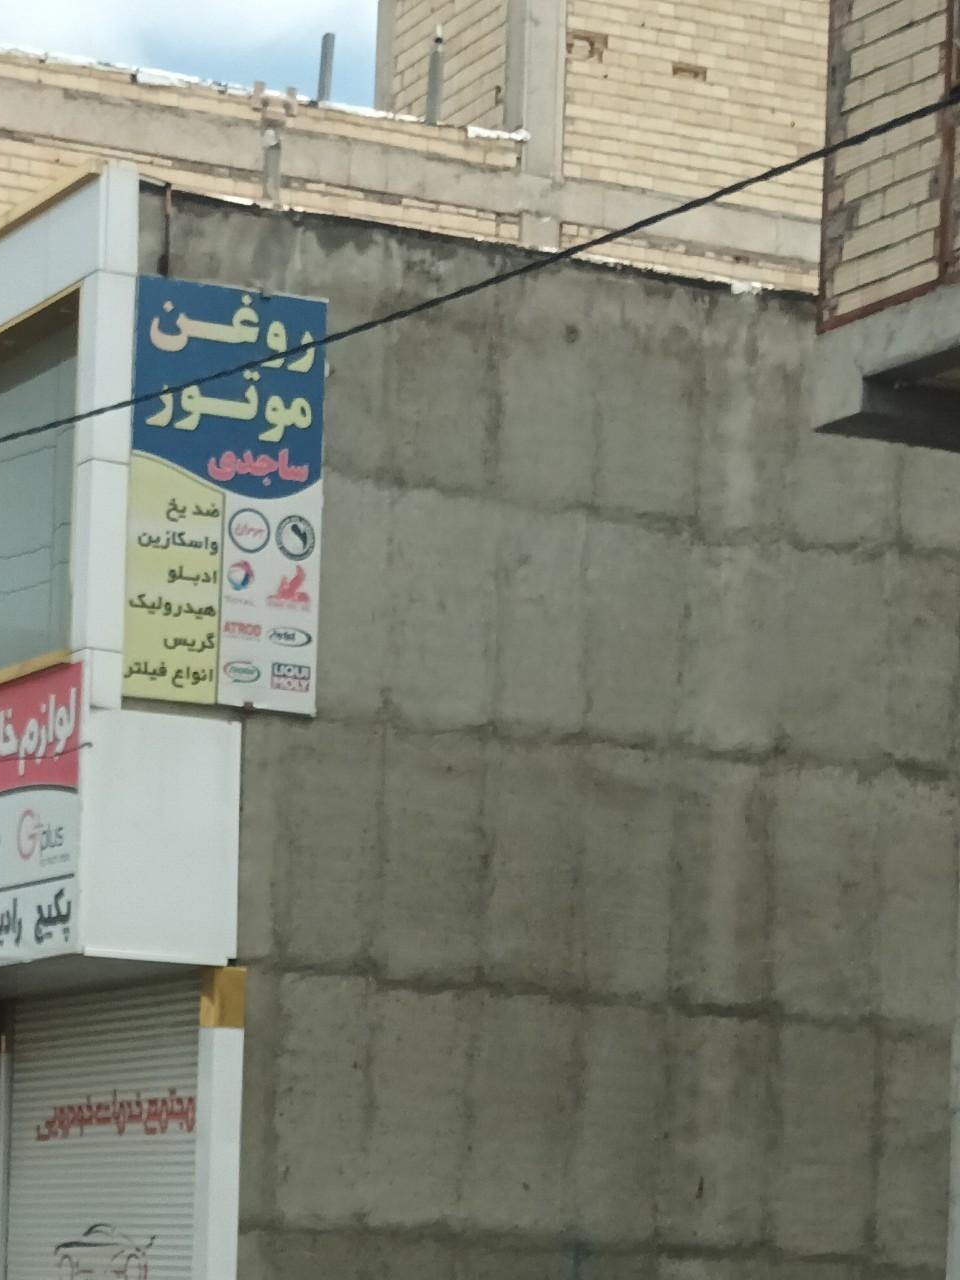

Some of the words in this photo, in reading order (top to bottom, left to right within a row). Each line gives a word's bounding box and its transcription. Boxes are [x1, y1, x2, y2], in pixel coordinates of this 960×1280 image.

[150, 294, 315, 373] روغن
[145, 369, 312, 442] موتور
[207, 449, 309, 487] ساجدی
[192, 501, 220, 519] ضد
[137, 530, 219, 555] واسکازین
[128, 592, 217, 620] هیدرولیک
[163, 632, 215, 652] گریس
[124, 661, 167, 679] فیلتر
[171, 666, 214, 688] انواع
[18, 688, 76, 776] لوازم
[34, 888, 72, 943] پکیج
